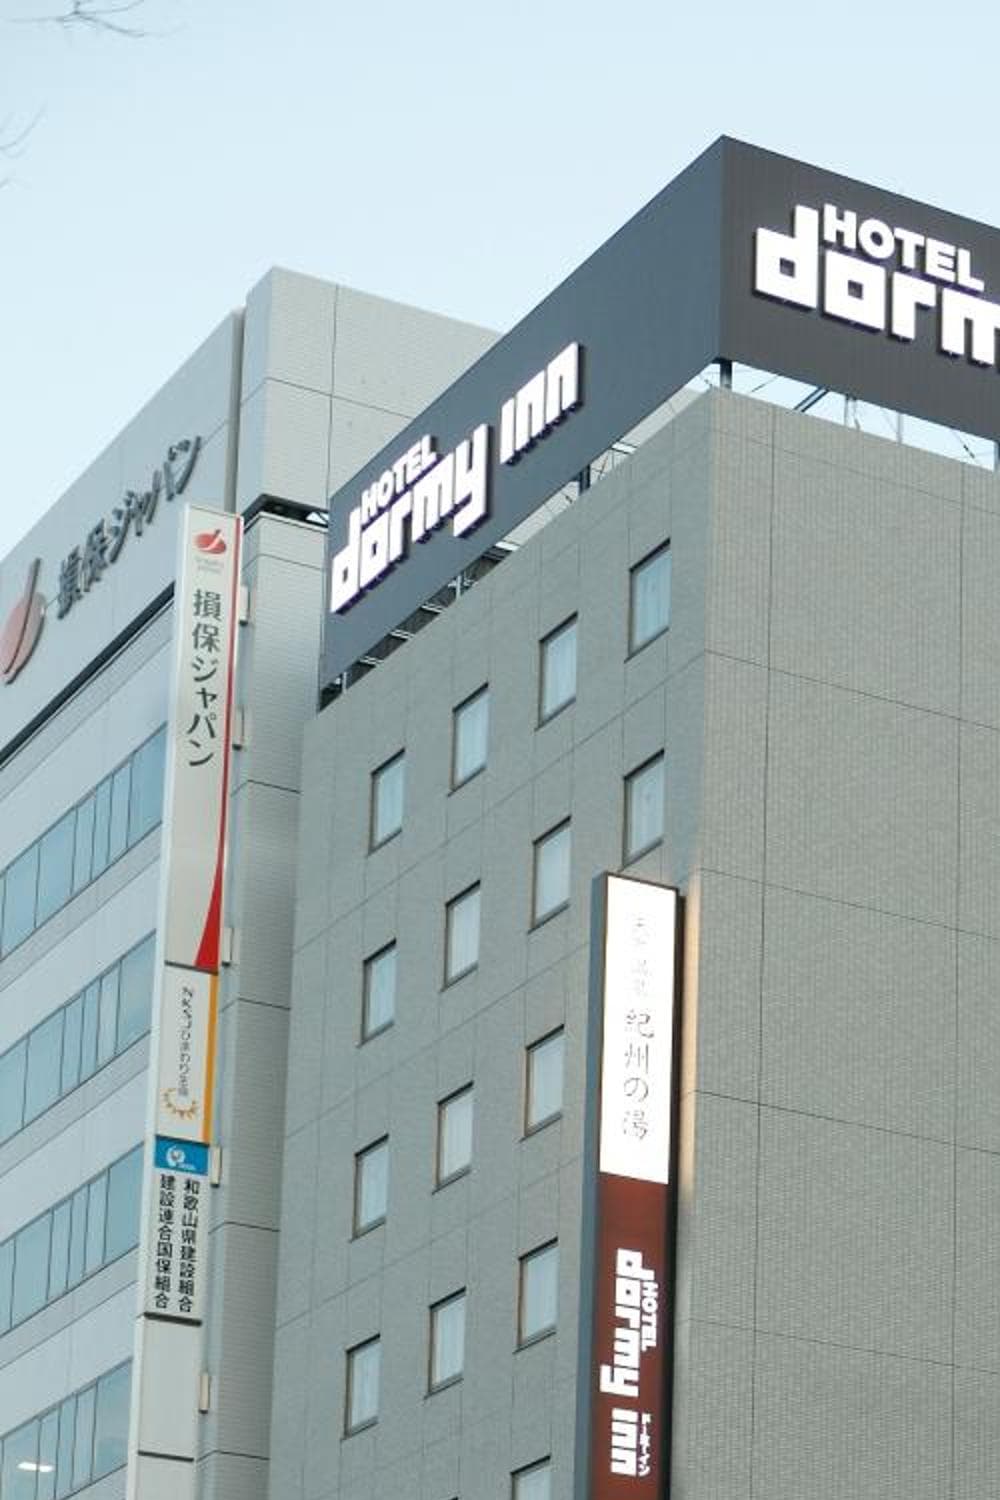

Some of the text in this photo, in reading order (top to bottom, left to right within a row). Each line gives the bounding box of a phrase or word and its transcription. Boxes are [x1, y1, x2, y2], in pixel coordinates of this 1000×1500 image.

[824, 204, 984, 291] HOTEL
[331, 424, 489, 614] dormy
[361, 435, 439, 525] HOTEL
[186, 588, 223, 767] 損保ジャパン
[154, 1173, 176, 1309] 建設連合国保組合
[178, 1178, 201, 1313] 和歌山県建設組合
[600, 1248, 655, 1397] dormy
[641, 1281, 659, 1352] HOTEL
